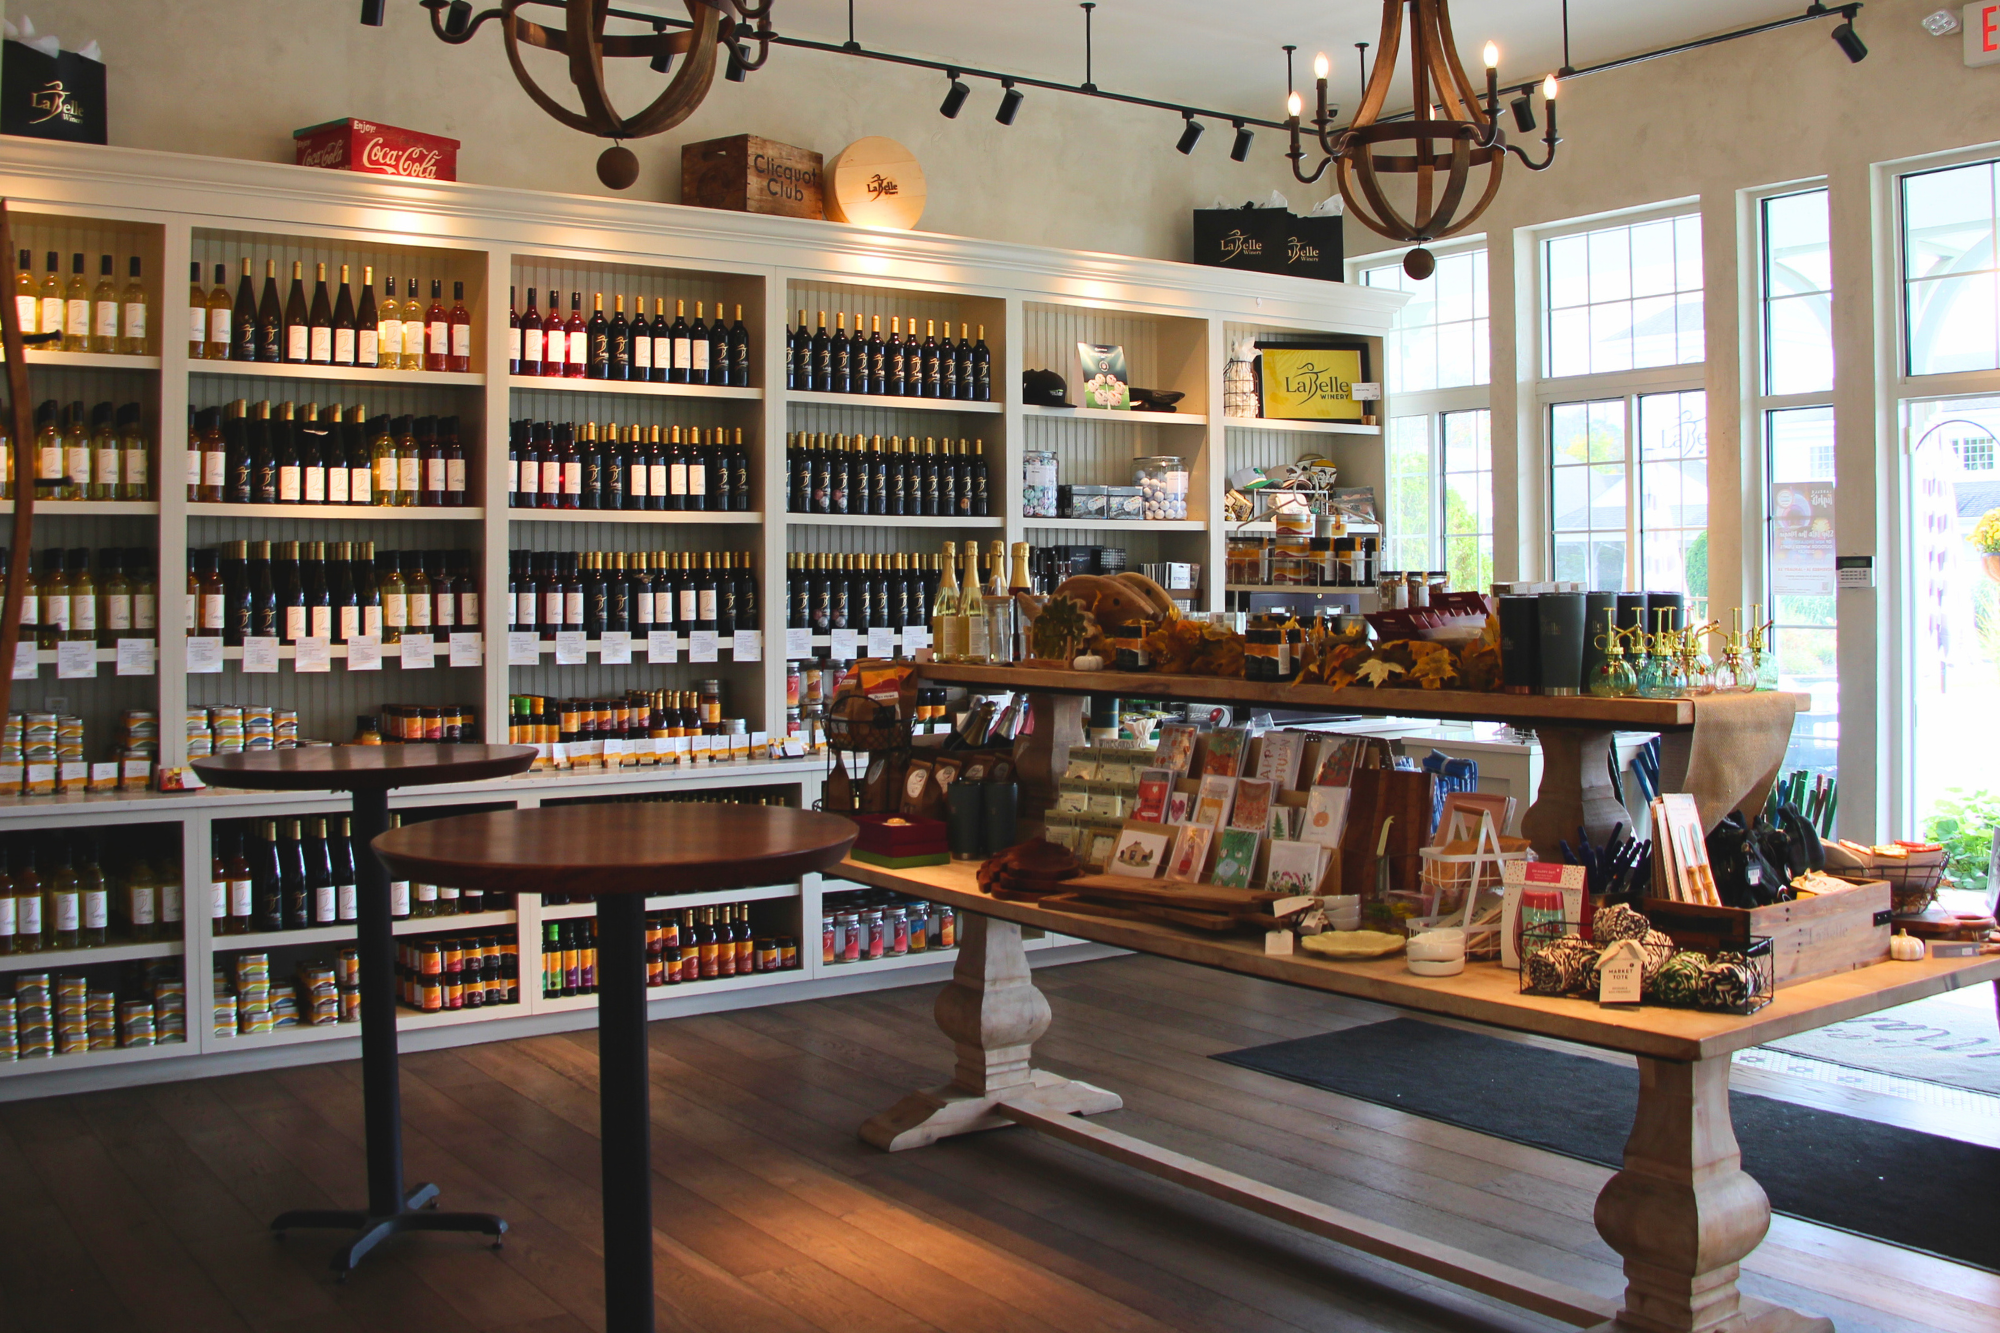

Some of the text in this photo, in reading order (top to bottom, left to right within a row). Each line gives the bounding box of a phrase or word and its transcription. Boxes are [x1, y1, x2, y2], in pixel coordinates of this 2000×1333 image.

[362, 137, 443, 180] Coca-Cola
[753, 153, 817, 187] Clicquot
[766, 177, 805, 202] Club
[1219, 229, 1263, 263] LaBelle
[1284, 361, 1350, 407] LaBelle
